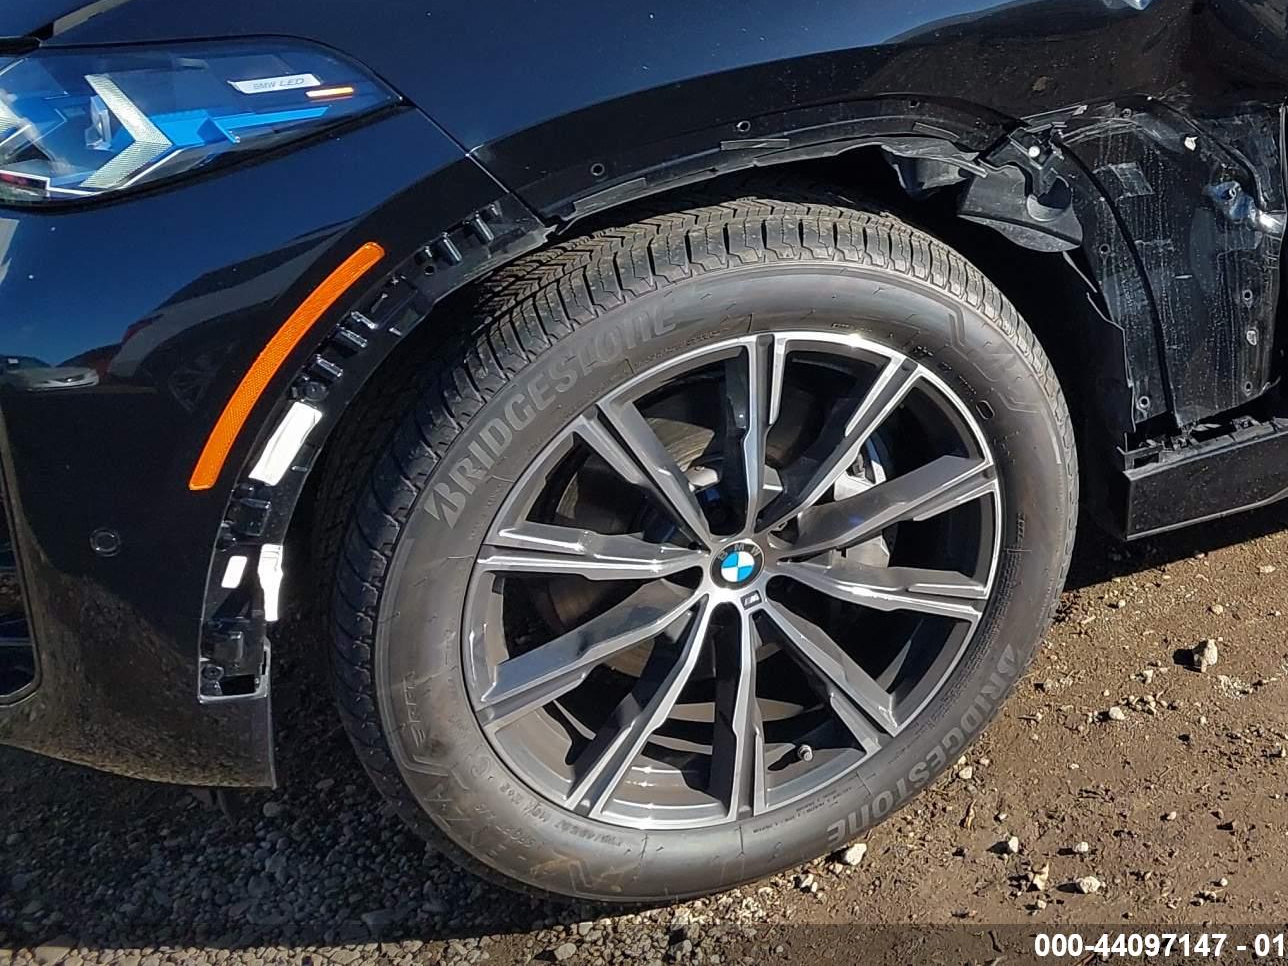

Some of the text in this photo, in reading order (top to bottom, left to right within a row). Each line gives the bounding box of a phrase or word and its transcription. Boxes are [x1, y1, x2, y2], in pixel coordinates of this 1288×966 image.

[253, 77, 305, 90] BMW LED
[424, 300, 677, 530] BRIDGESTONE
[718, 543, 761, 561] BMW
[825, 643, 1025, 847] BRIDGESTONE
